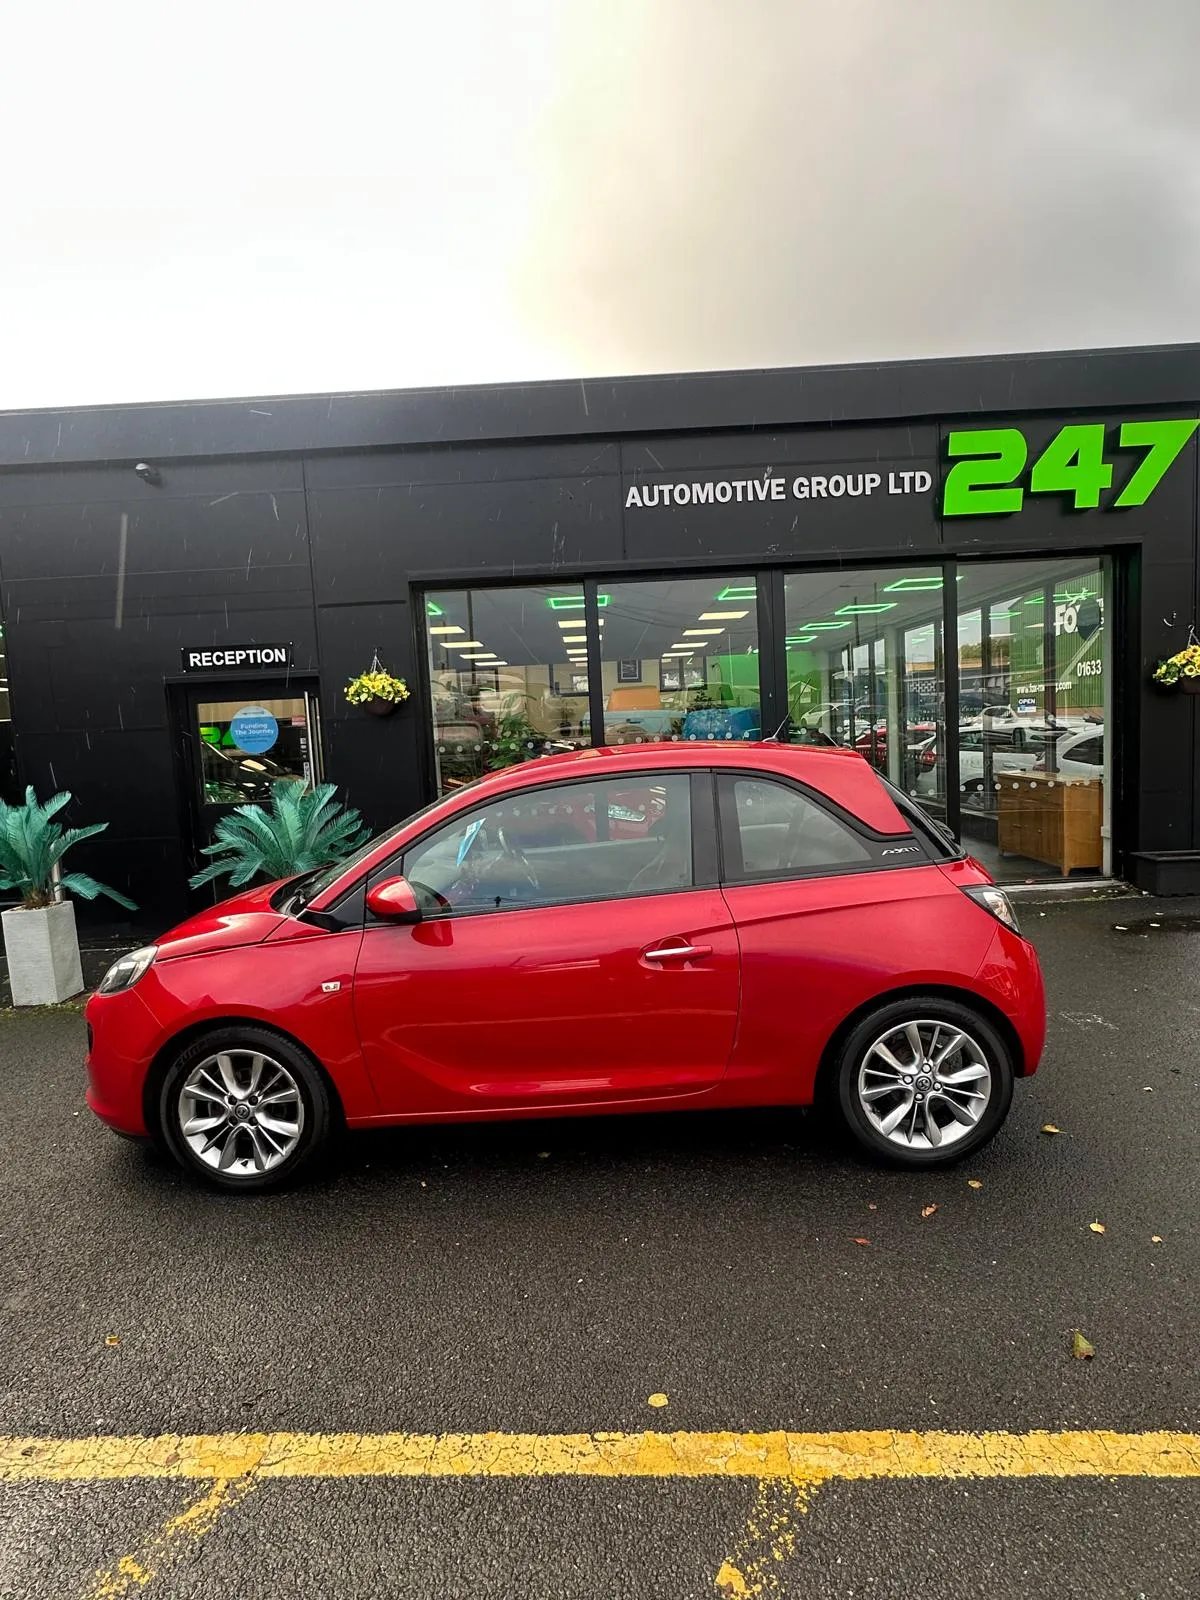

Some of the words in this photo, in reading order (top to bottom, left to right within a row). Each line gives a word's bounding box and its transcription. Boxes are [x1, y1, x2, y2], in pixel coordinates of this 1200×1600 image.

[943, 420, 1199, 516] 247
[626, 477, 786, 507] AUTOMOTIVE
[792, 474, 881, 499] GROUP
[888, 471, 932, 494] LTD
[189, 648, 287, 667] RECEPTION
[1077, 659, 1102, 677] 01633
[248, 728, 274, 736] Journey
